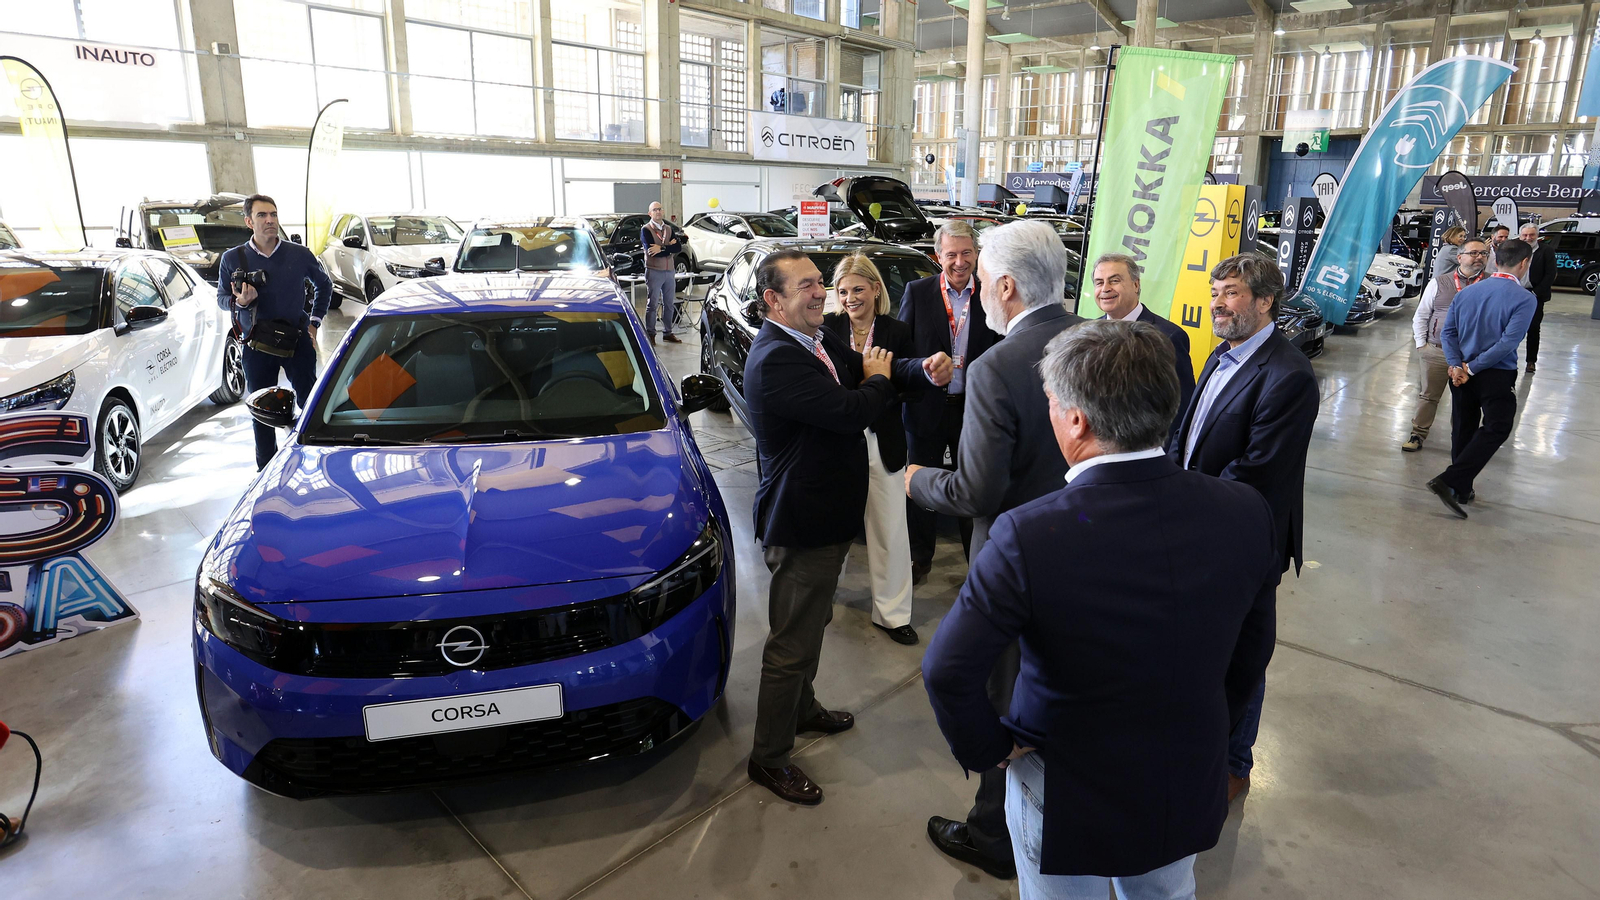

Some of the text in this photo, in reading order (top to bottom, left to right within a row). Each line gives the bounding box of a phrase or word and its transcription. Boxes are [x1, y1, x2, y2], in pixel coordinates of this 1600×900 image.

[75, 45, 156, 67] INAUTO
[778, 133, 855, 151] CITROËN
[1121, 115, 1181, 275] MOKKA
[1472, 183, 1594, 198] ercedes-Benz
[156, 348, 172, 363] CORSA
[431, 702, 501, 722] CORSA
